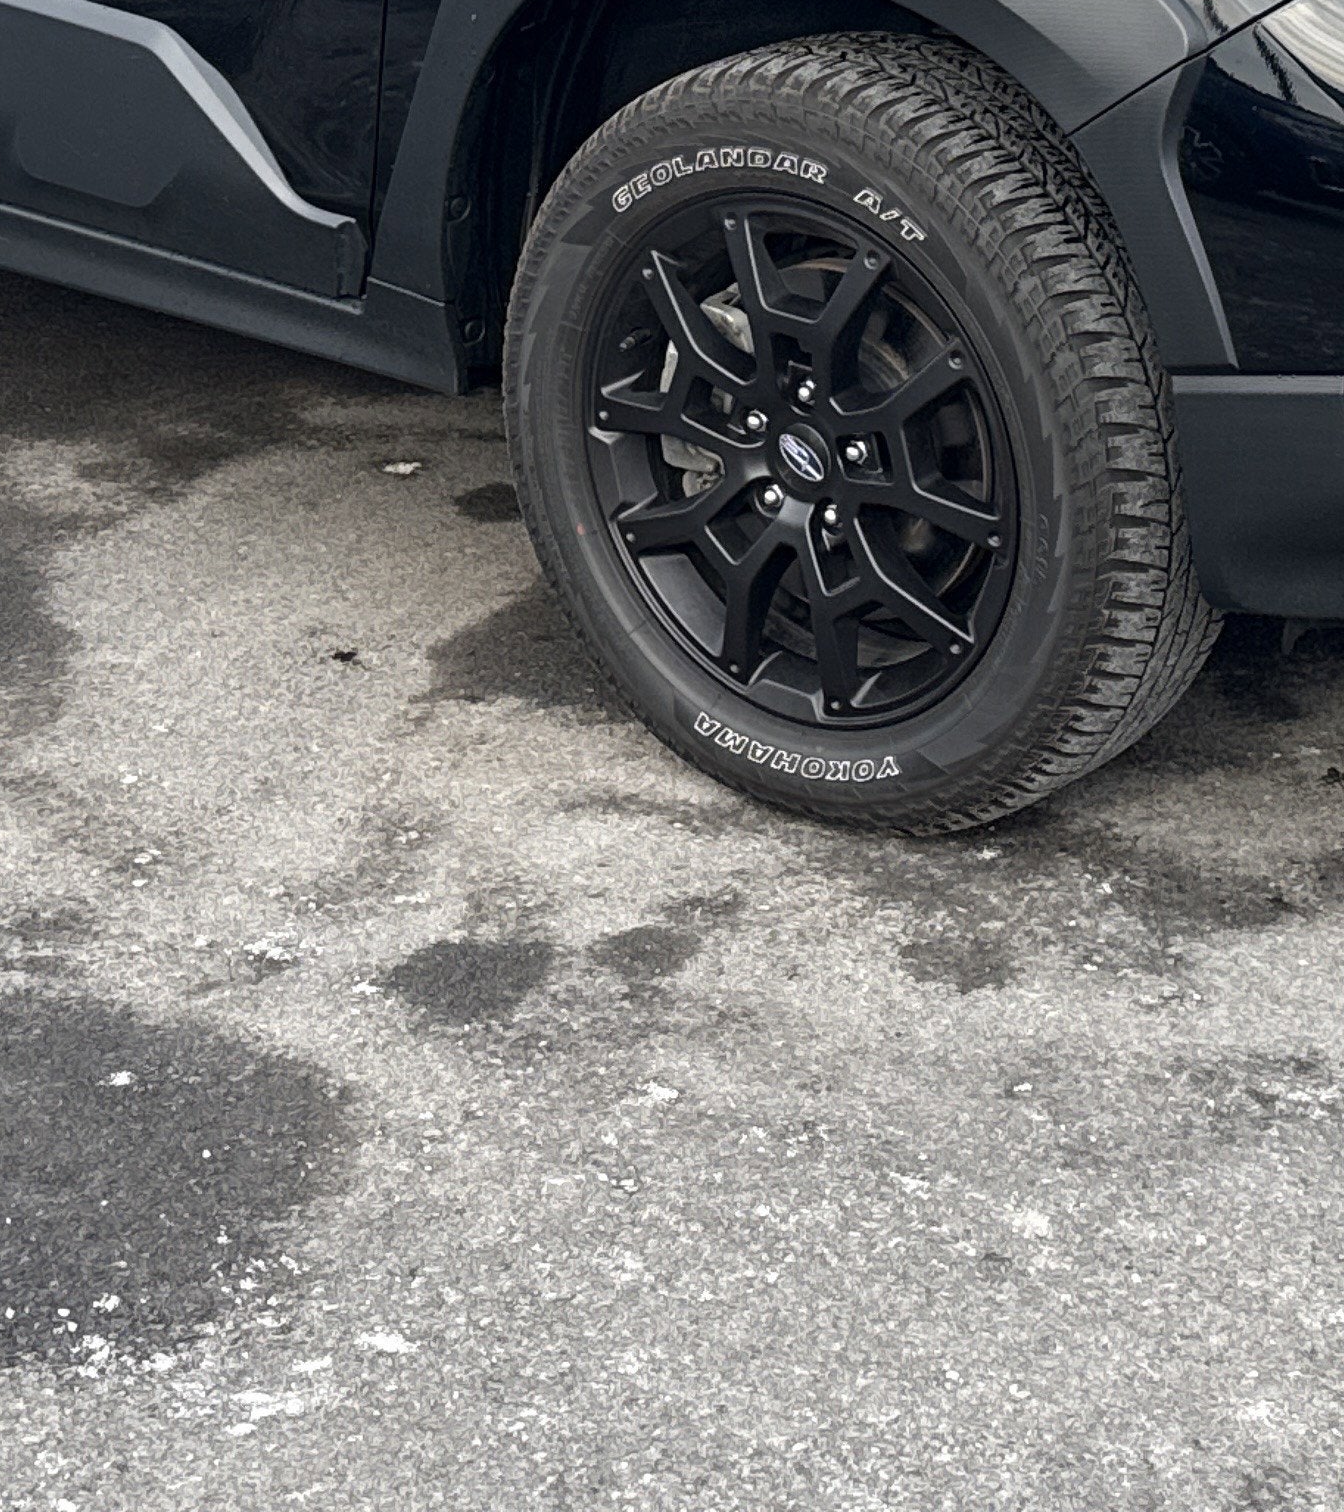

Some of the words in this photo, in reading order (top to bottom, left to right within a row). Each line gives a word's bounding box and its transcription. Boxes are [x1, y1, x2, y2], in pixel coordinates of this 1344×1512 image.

[611, 147, 829, 213] GEOLANDAR
[852, 187, 926, 242] A/T
[693, 711, 900, 782] YOKOHAMA
